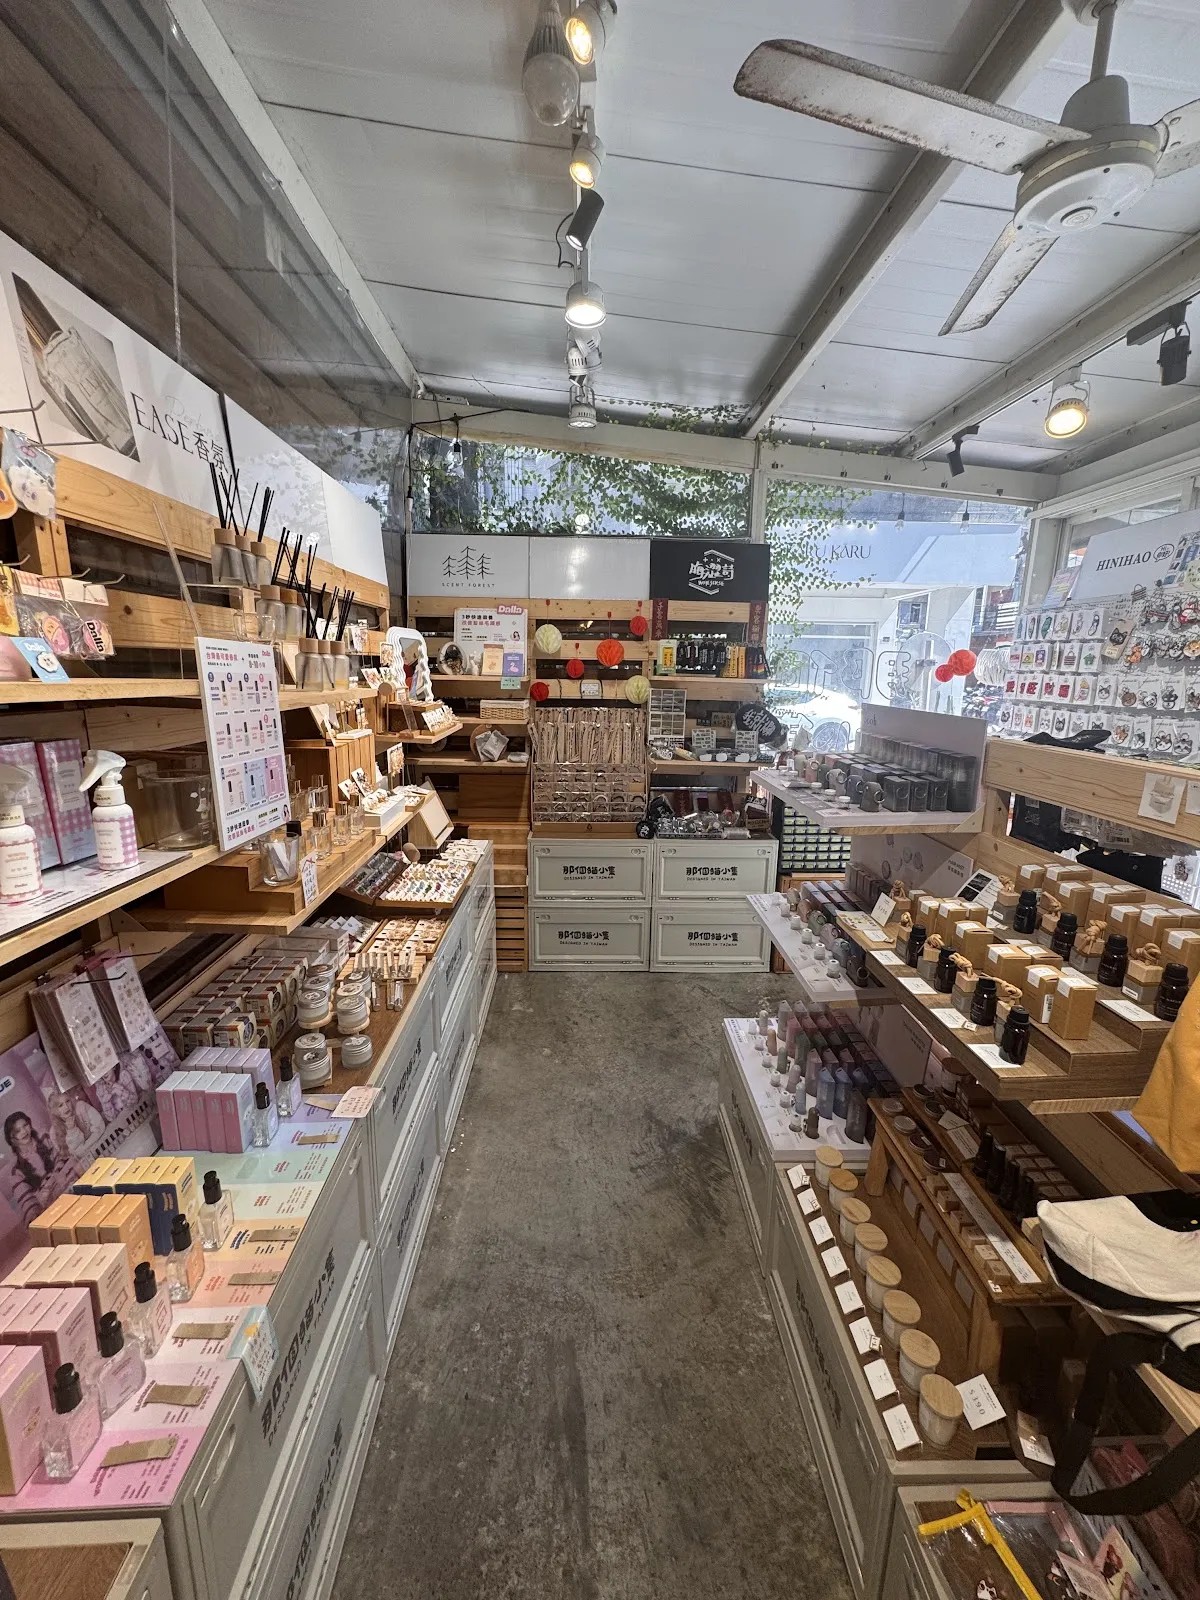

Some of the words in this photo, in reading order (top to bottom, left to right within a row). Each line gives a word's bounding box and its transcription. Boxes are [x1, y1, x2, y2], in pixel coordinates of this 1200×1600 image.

[831, 543, 872, 559] KARU
[1096, 551, 1151, 571] HINIHAO
[498, 605, 523, 614] Dalla
[87, 622, 105, 652] Dalla
